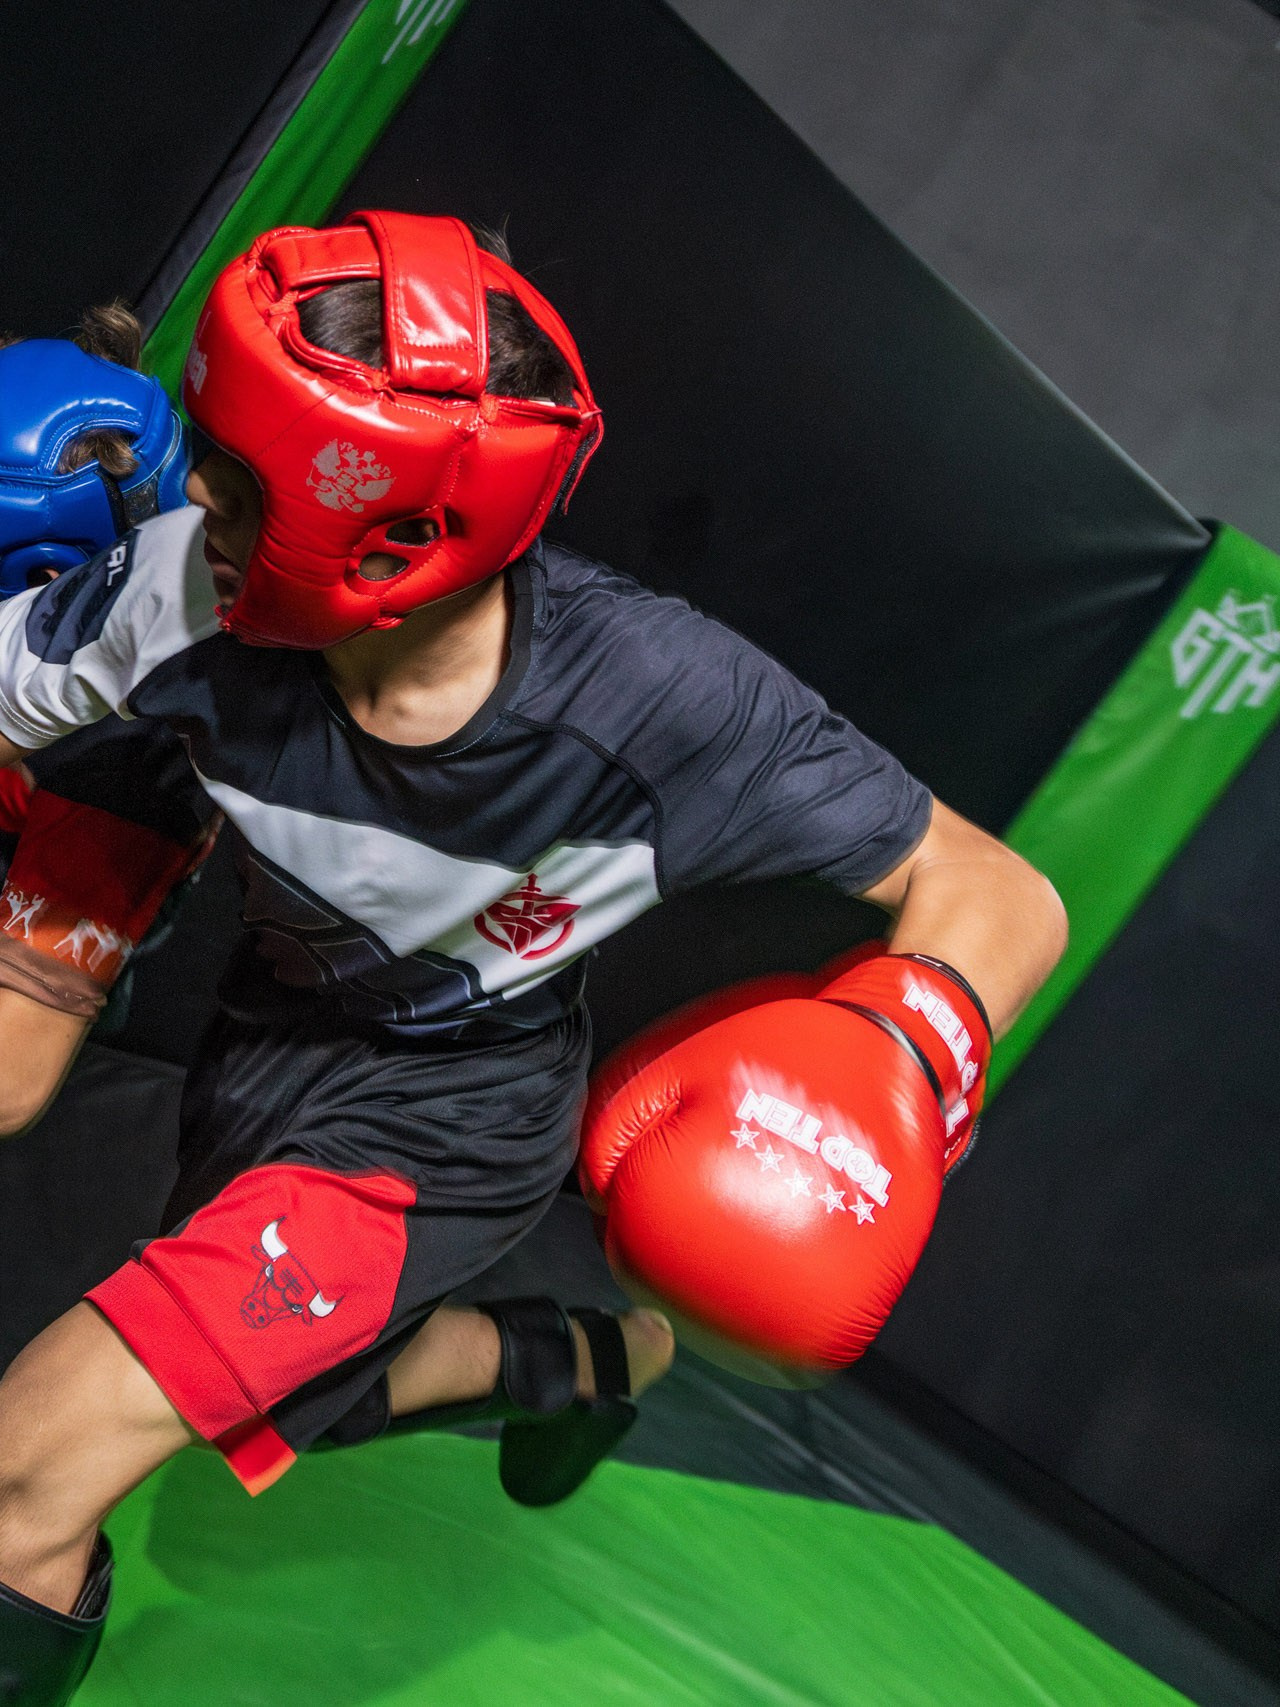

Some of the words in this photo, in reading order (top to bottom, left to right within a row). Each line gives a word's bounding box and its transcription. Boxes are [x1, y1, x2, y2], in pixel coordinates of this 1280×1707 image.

[901, 982, 973, 1072] TEN
[735, 1088, 823, 1155] TEN
[946, 1061, 978, 1138] TP
[819, 1134, 893, 1208] TOP
